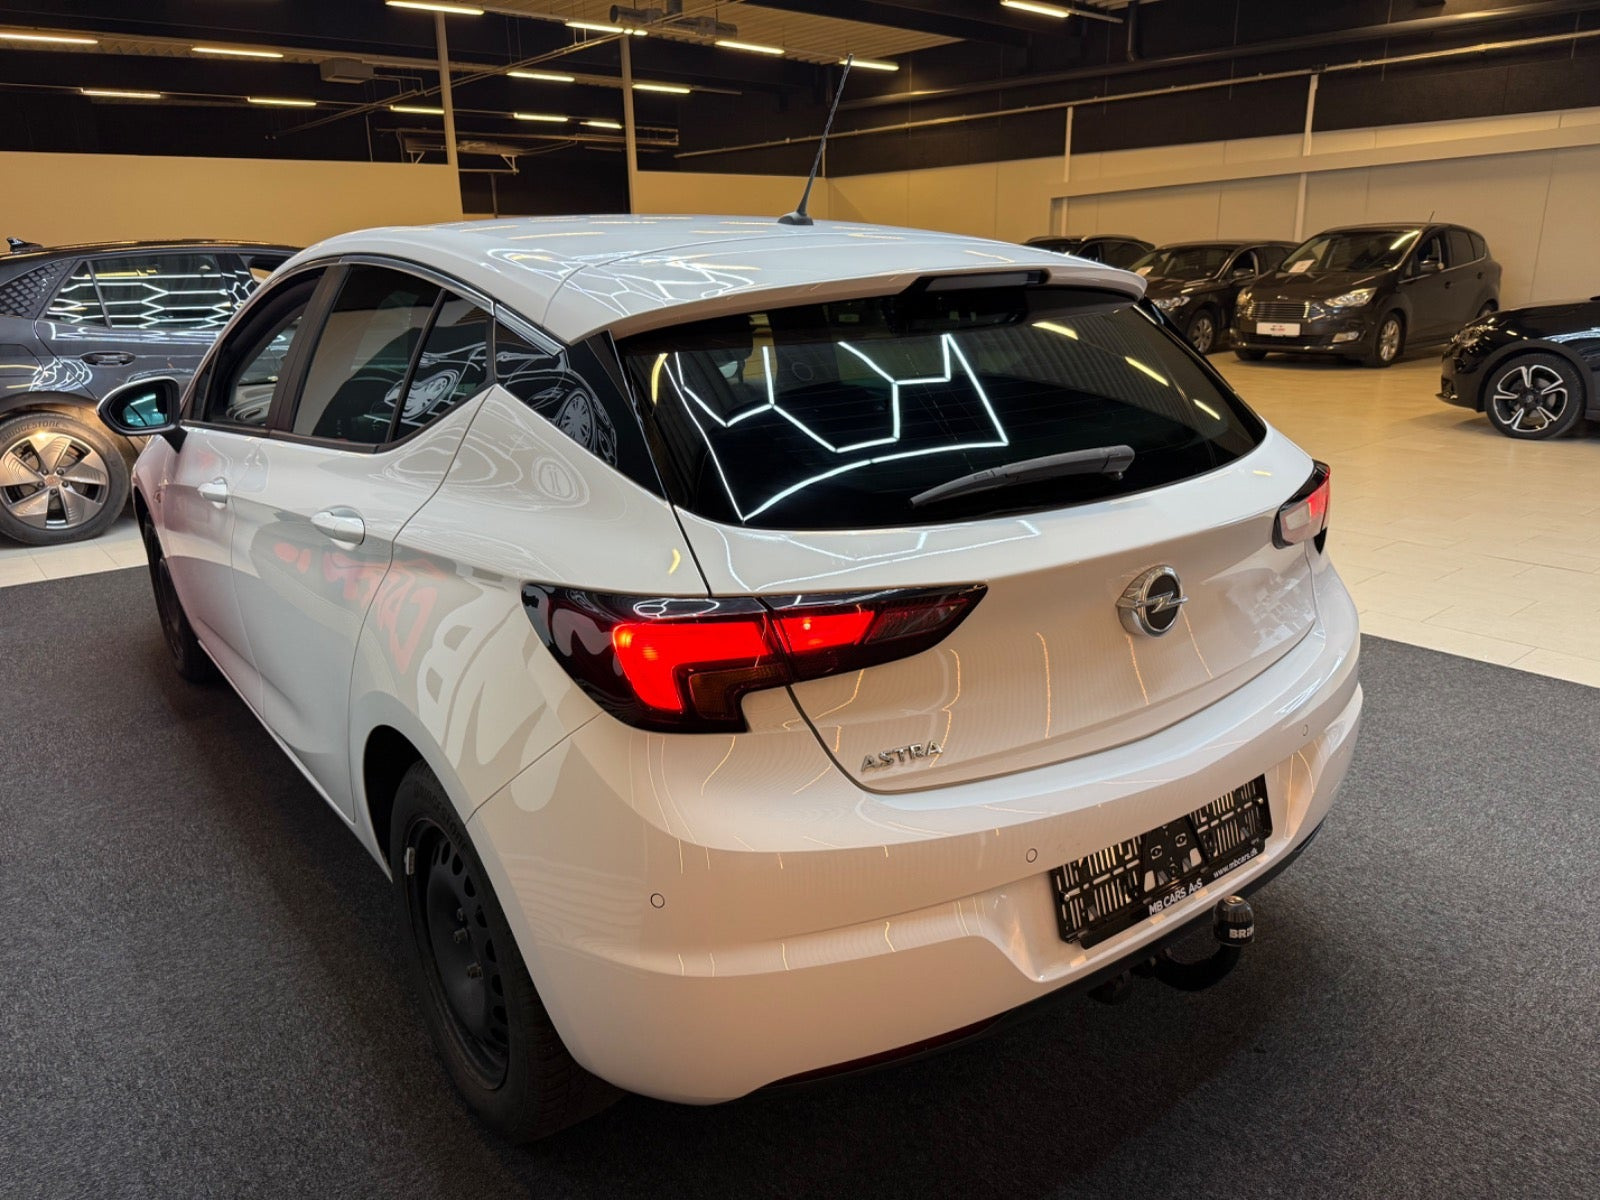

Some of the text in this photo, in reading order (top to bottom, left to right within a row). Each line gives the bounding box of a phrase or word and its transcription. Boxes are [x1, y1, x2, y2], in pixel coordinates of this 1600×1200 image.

[861, 741, 943, 772] ASTRA
[1148, 900, 1163, 915] MB
[1163, 887, 1187, 907] CARS
